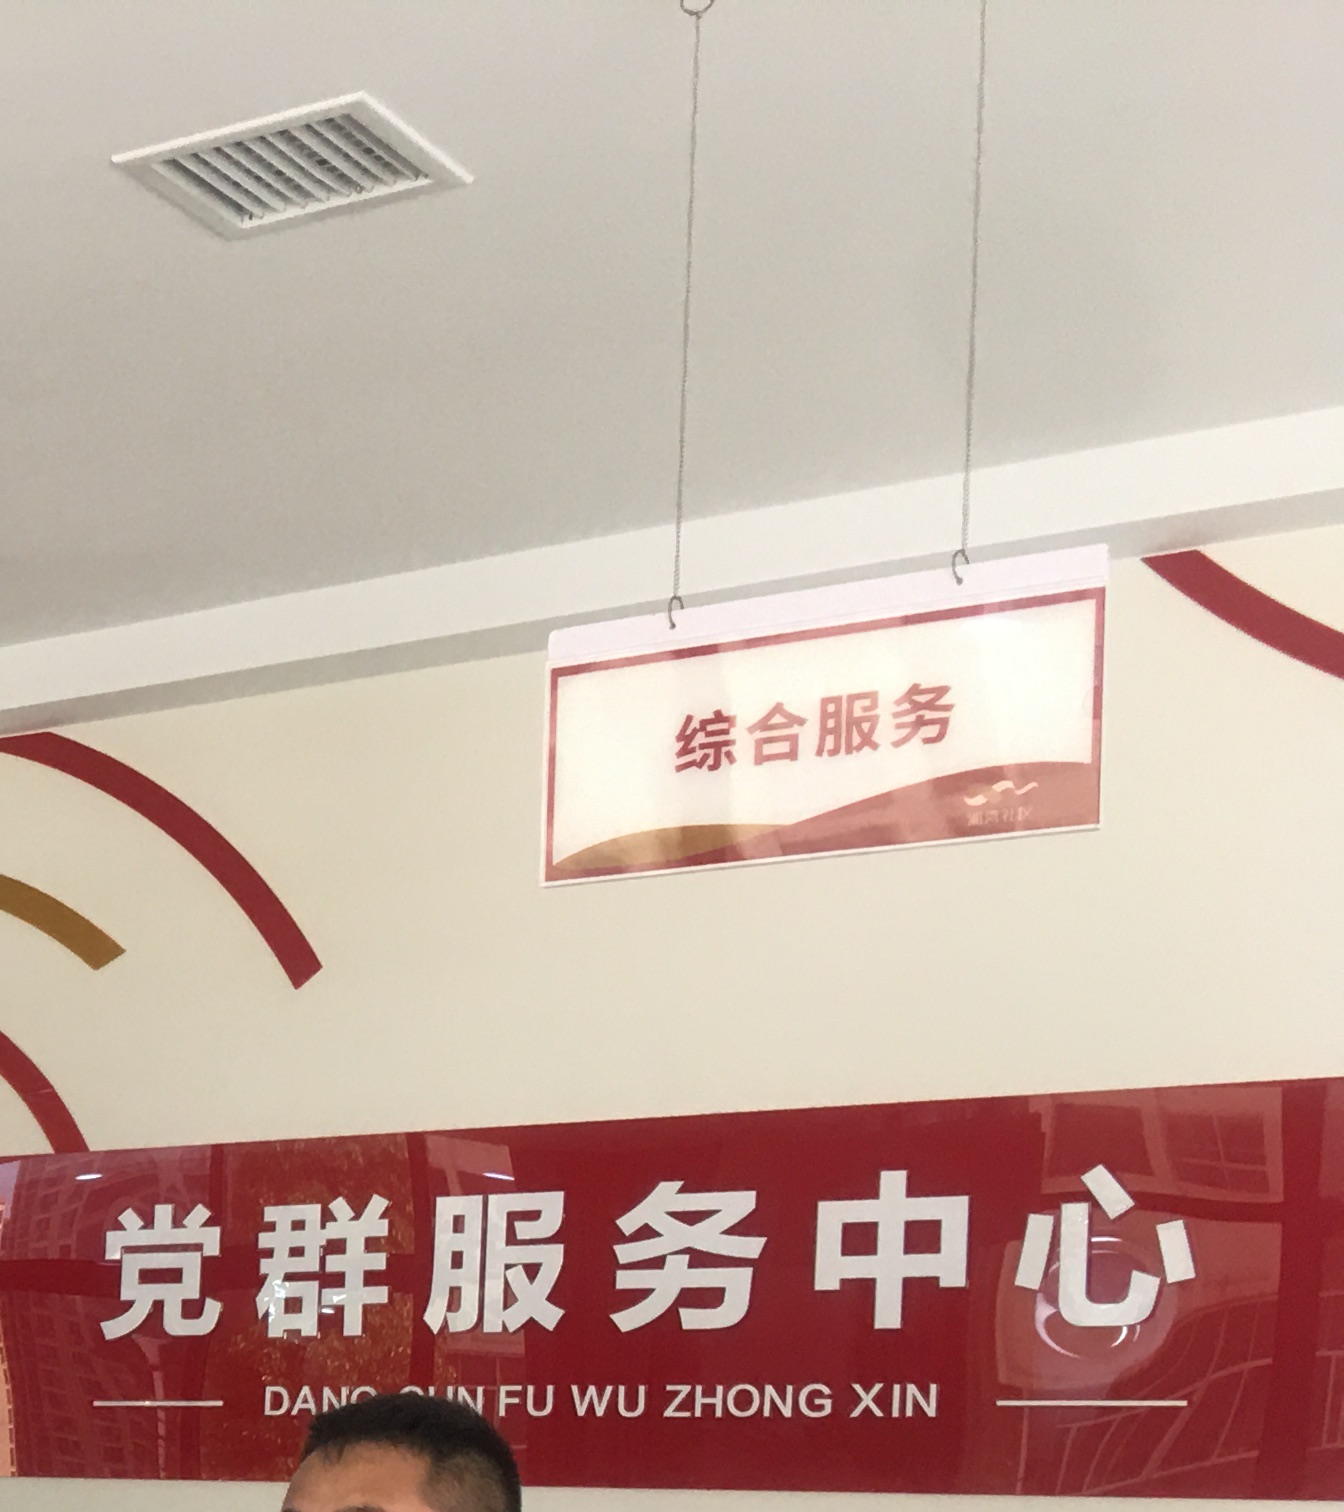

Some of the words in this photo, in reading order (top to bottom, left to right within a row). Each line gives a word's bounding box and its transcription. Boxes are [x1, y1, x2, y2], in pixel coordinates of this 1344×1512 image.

[674, 682, 956, 773] 综合服务
[98, 1164, 1198, 1341] 党群服务中心
[498, 1384, 556, 1417] FU
[571, 1384, 646, 1418] WU
[662, 1383, 833, 1419] ZHONG
[849, 1382, 939, 1419] XIN
